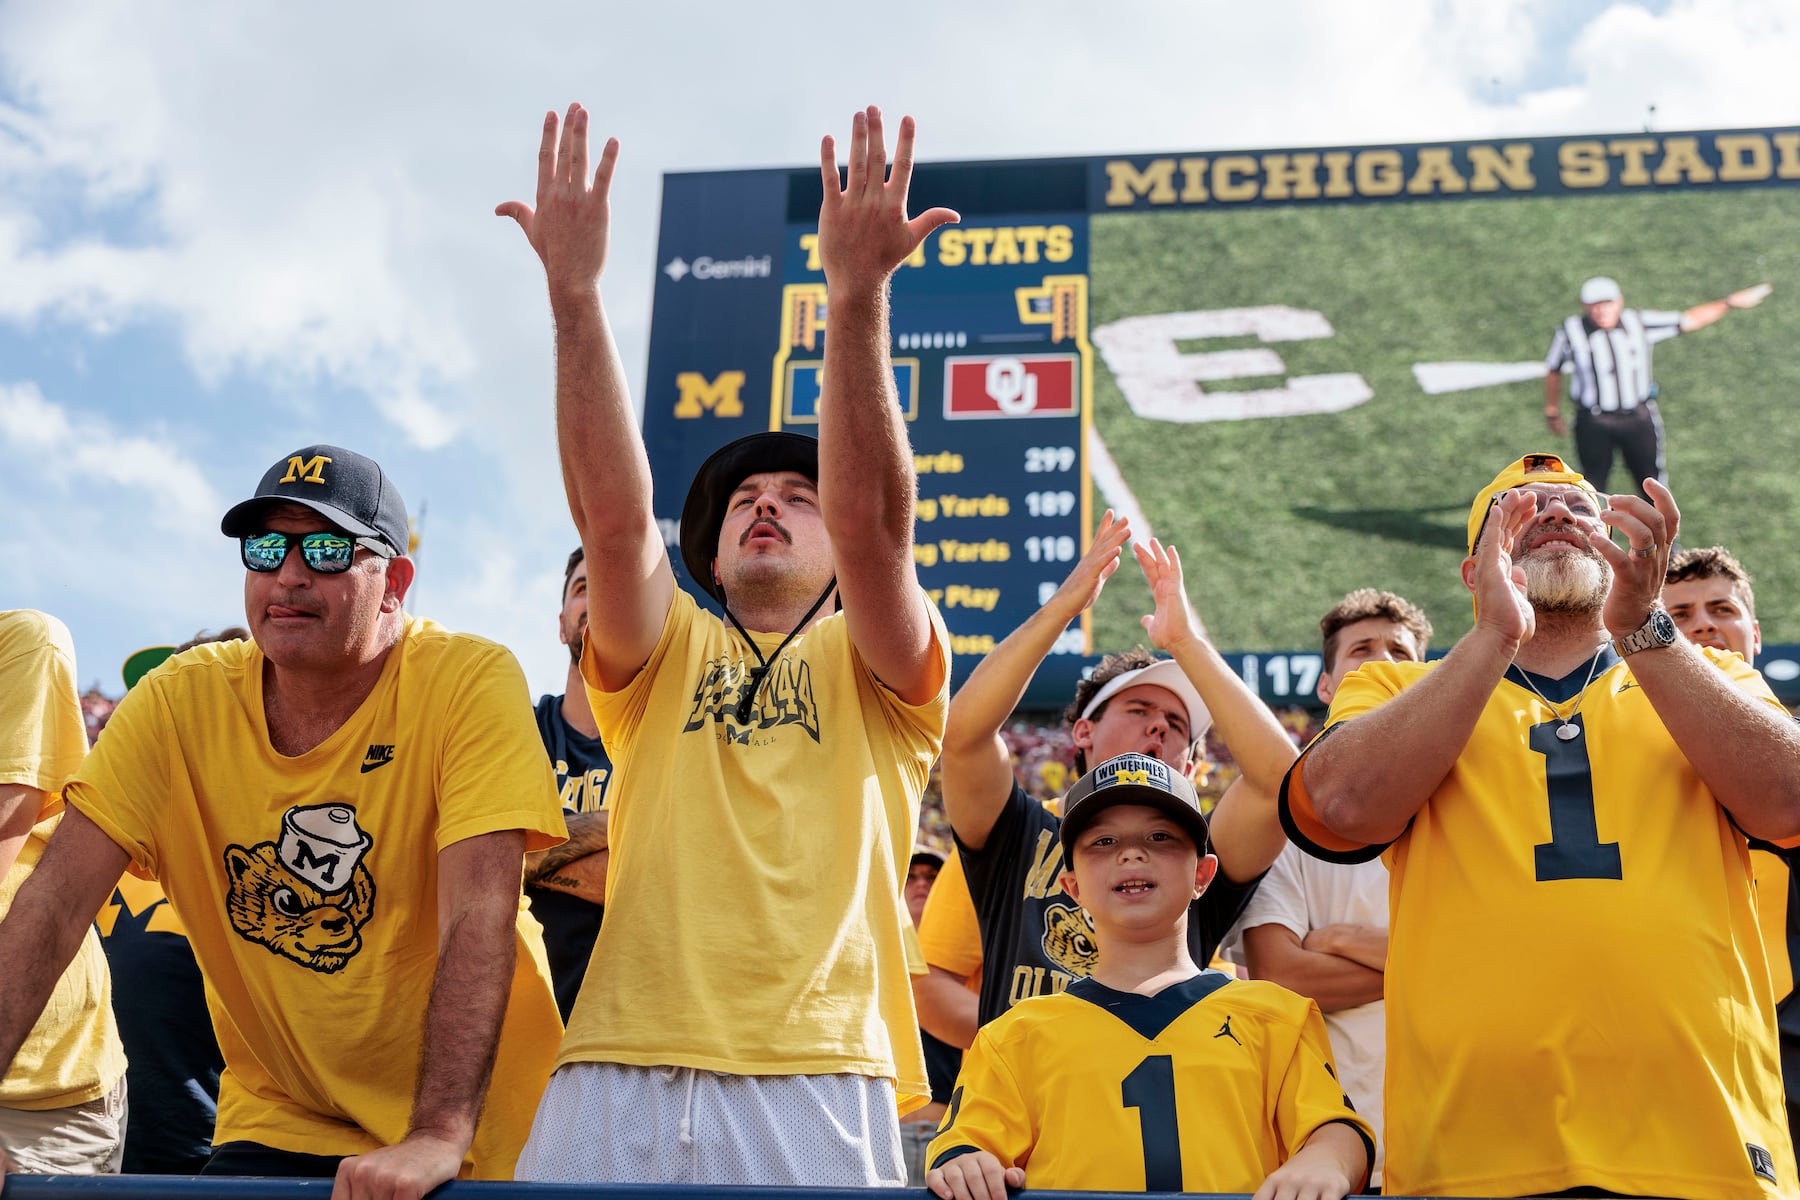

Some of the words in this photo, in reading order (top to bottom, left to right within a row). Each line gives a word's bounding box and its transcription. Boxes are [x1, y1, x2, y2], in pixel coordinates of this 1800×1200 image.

[1105, 144, 1535, 206] MICHIGAN
[938, 224, 1073, 266] STATS
[692, 255, 771, 279] Gemini
[674, 371, 745, 418] M
[984, 356, 1038, 415] OU
[279, 455, 332, 484] M
[913, 451, 964, 474] ards
[939, 494, 1009, 517] Yards
[939, 538, 1010, 562] Yards
[945, 585, 1000, 612] Play
[1265, 655, 1322, 696] 17
[366, 744, 395, 762] NIKE
[1098, 760, 1165, 780] WOLVERINES
[1115, 769, 1152, 786] M
[1529, 711, 1623, 882] 1
[296, 839, 343, 885] M
[1121, 1054, 1183, 1192] 1
